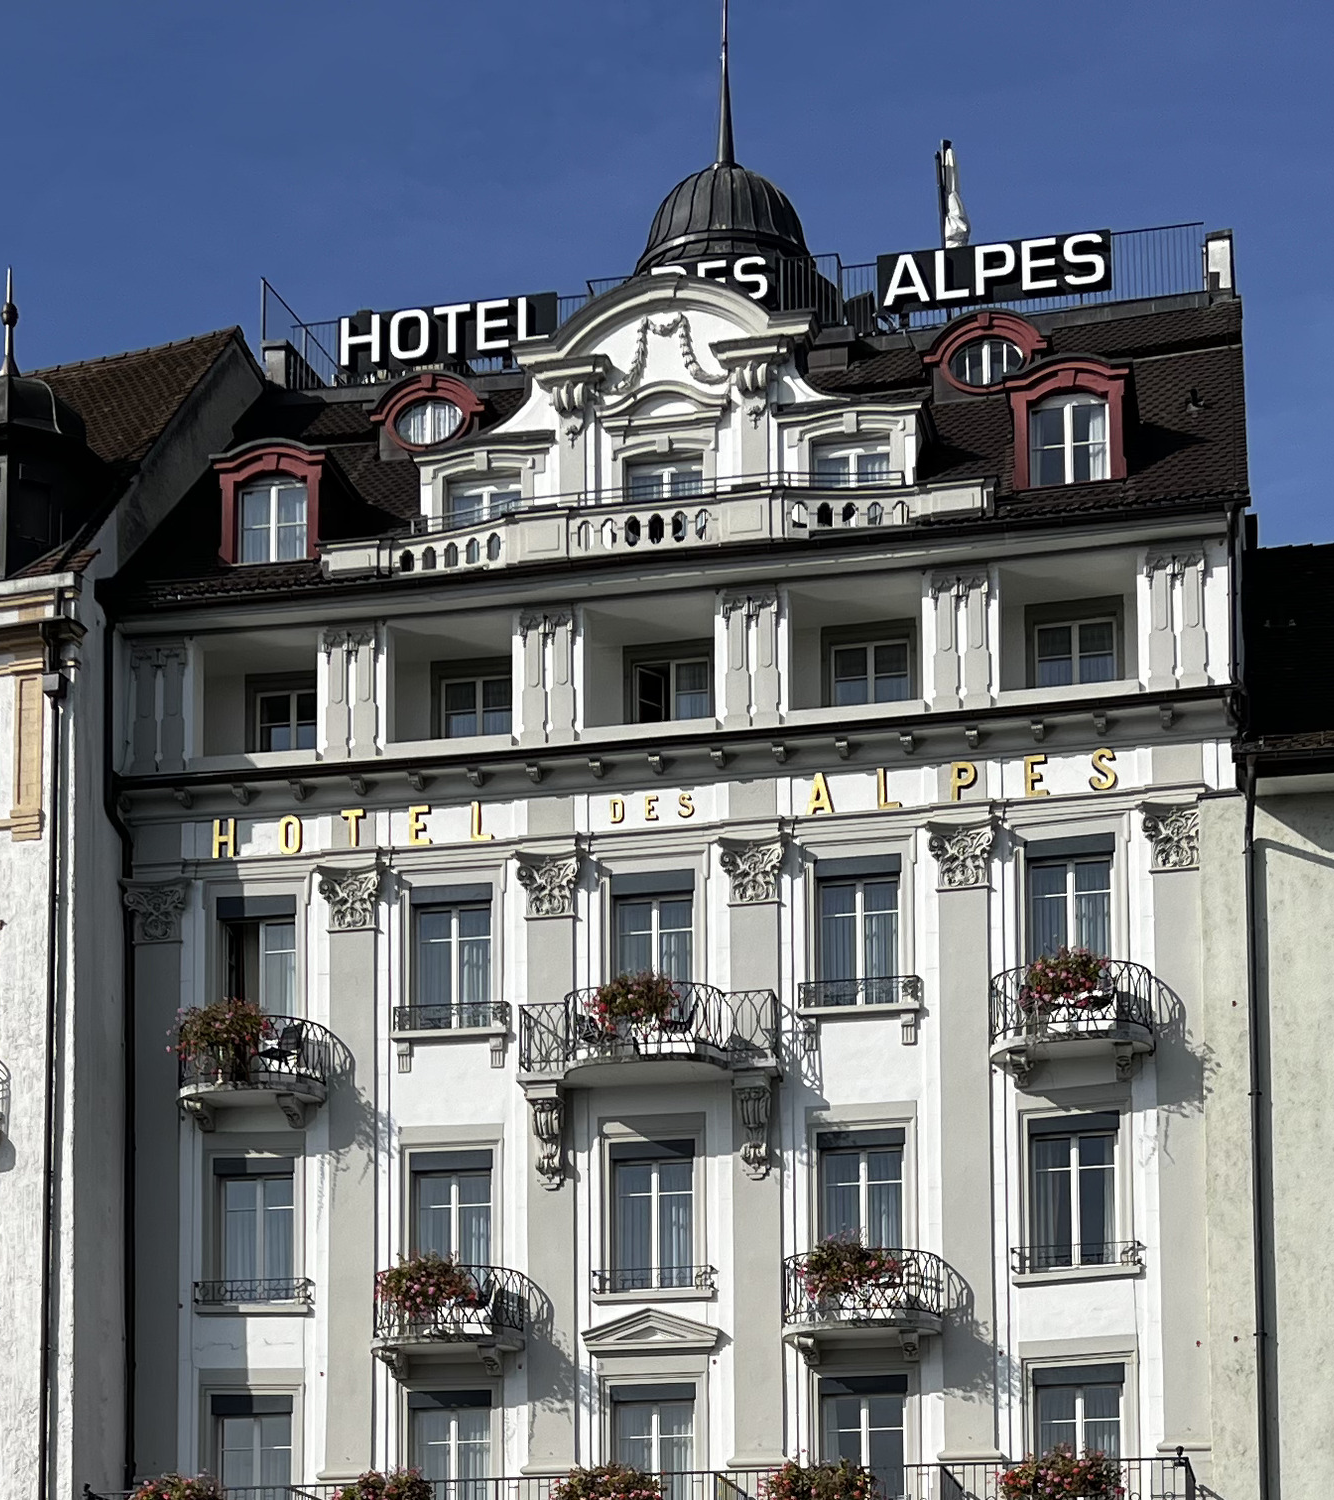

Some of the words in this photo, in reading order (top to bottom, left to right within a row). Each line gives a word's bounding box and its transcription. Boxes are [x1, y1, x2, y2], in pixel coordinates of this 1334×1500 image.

[340, 296, 550, 366] HOTEL
[883, 232, 1106, 307] ALPES
[212, 800, 495, 859] HOTEL
[609, 793, 695, 824] DES
[805, 747, 1120, 815] ALPES
